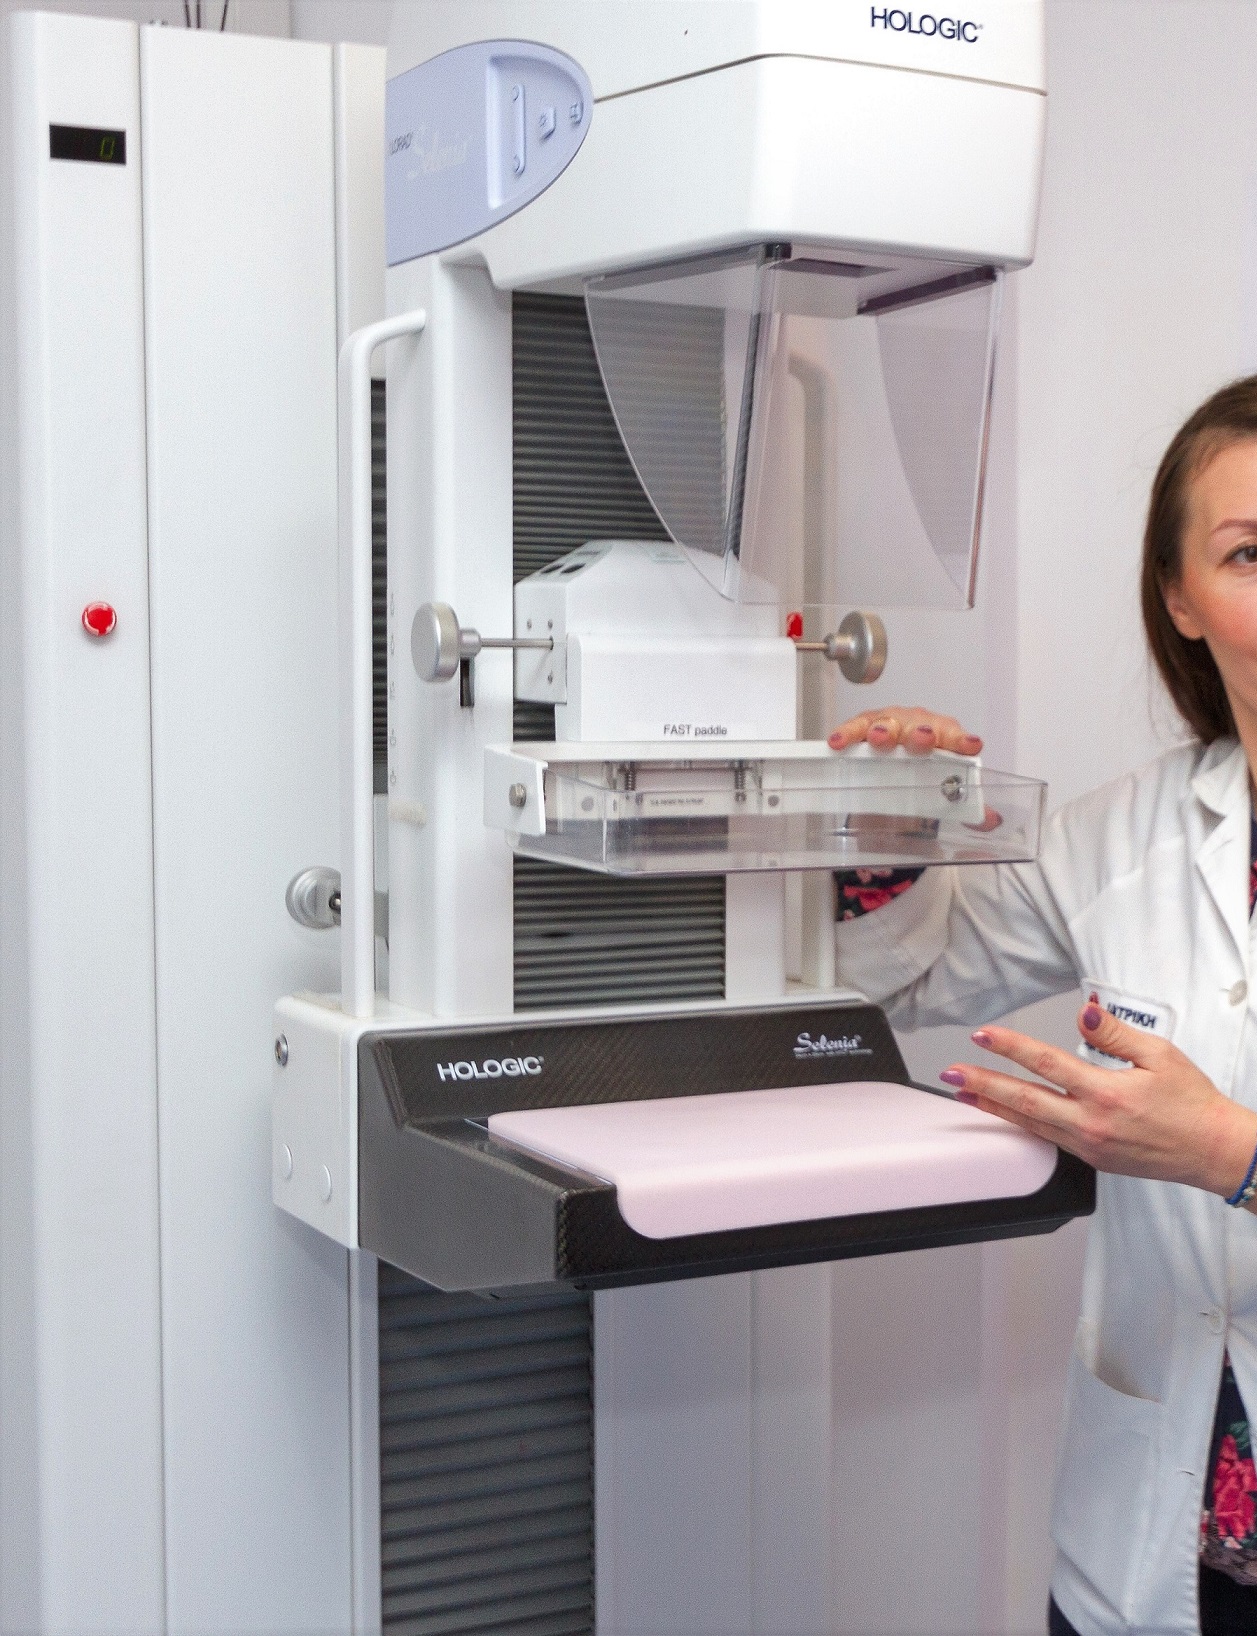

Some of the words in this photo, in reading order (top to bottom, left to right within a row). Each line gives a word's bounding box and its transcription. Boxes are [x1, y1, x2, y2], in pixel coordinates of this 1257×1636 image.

[870, 5, 979, 44] HOLOGIC
[100, 136, 116, 160] 0
[663, 723, 692, 735] FAST
[694, 724, 728, 737] paddle
[436, 1055, 543, 1083] HOLOGIC
